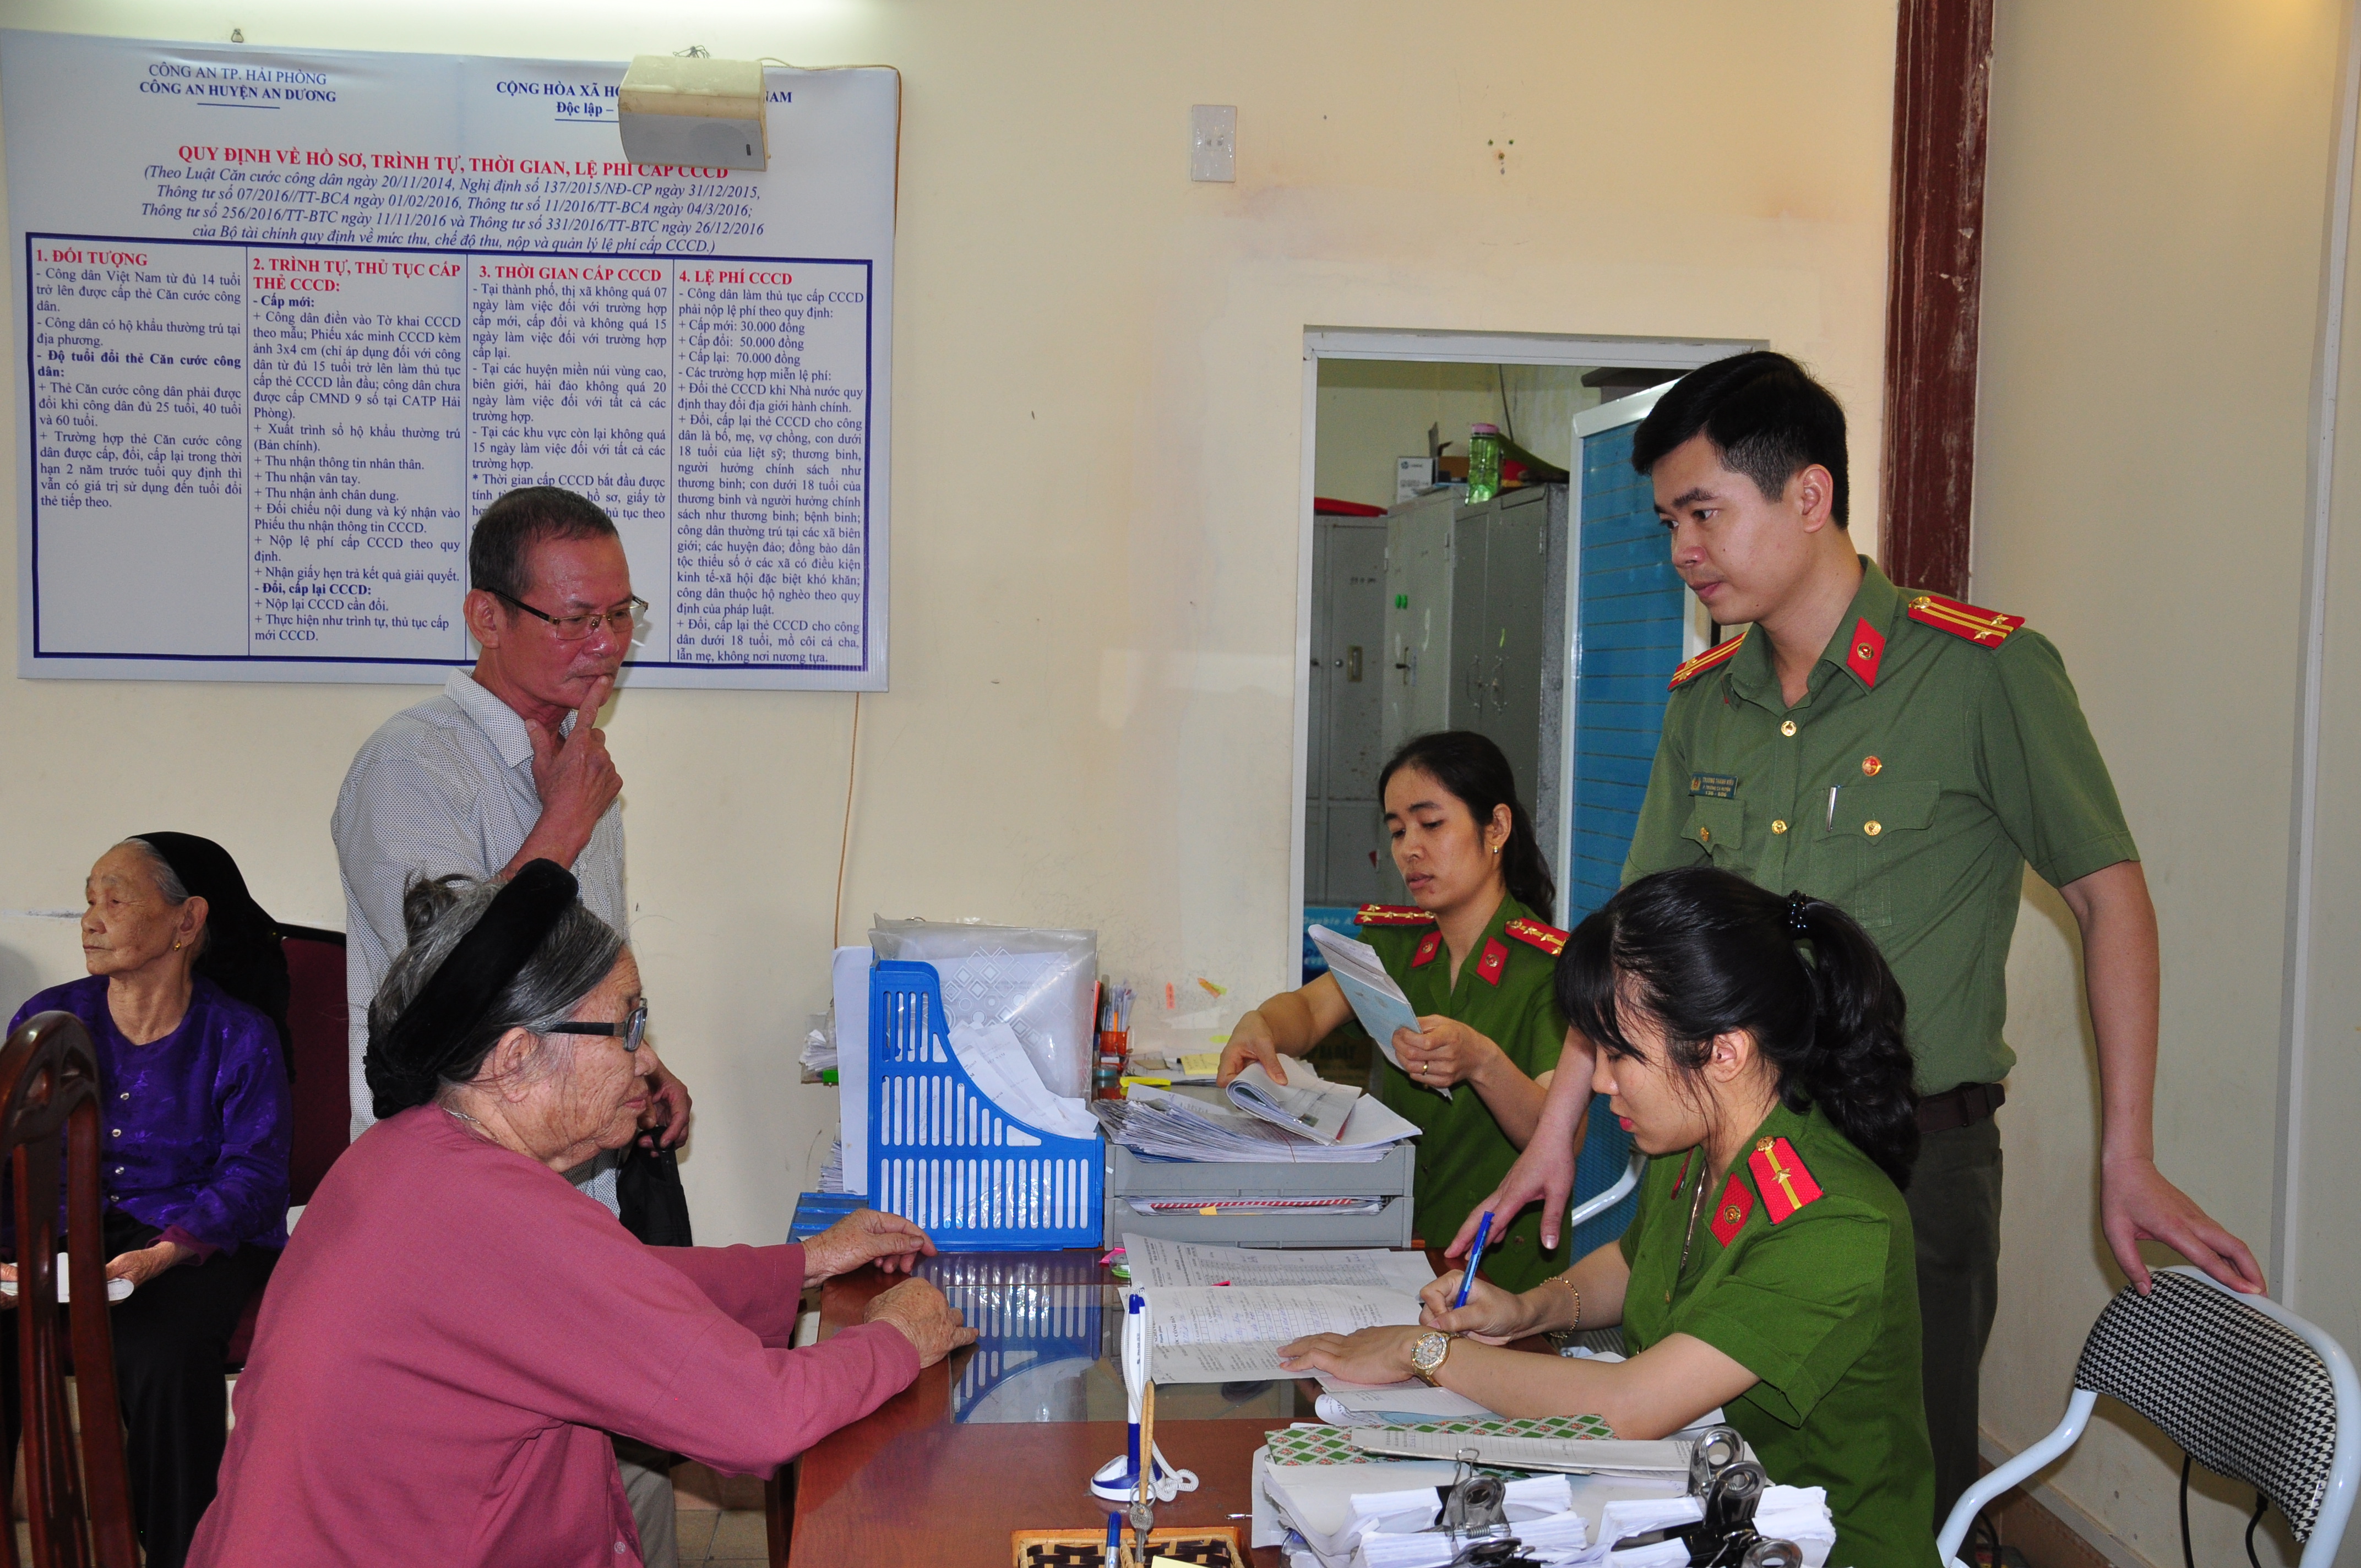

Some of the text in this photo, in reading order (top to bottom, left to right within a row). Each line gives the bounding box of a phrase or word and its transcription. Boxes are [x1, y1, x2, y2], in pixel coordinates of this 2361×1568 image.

[149, 64, 326, 85] CÔNG AN TP. HẢI PHÒNG
[139, 78, 336, 102] CÔNG AN HUYỆN AN DƯƠNG
[496, 79, 539, 97] CỘNG
[543, 80, 575, 96] HÒA
[580, 81, 600, 96] XÃ
[766, 91, 792, 103] AM
[556, 101, 602, 117] Độc lập
[178, 145, 219, 164] QUY
[224, 148, 271, 166] ĐỊNH
[276, 145, 301, 165] VỀ
[306, 147, 333, 166] HỒ
[338, 151, 366, 170] SƠ,
[371, 150, 429, 170] TRÌNH
[434, 154, 465, 175] TỰ,
[469, 153, 514, 173] THỜI
[520, 159, 570, 177] GIAN,
[575, 159, 597, 179] LỆ
[678, 166, 728, 179] CCCD
[144, 165, 760, 199] (Theo Luật Căn cước công dân ngày 20/11/2014, Nghị định số 137/2015/NĐ-CP ngày 31/12/2015,
[157, 184, 198, 202] Thông
[202, 188, 216, 199] tư
[218, 187, 232, 199] số
[353, 193, 385, 209] ngày
[388, 193, 461, 210] 01/02/2016,
[468, 196, 507, 213] Thông
[510, 200, 526, 211] tư
[528, 195, 541, 211] số
[546, 199, 649, 215] 11/2016/TT-BCA
[653, 201, 683, 218] ngày
[687, 202, 752, 217] 04/3/2016;
[142, 202, 764, 236] Thông tư số 256/2016/TT-BTC ngày 11/11/2016 và Thông tư số 331/2016/TT-BTC ngày 26/12/2016
[193, 224, 715, 254] của Bộ tài chính quy định về mức thu, chế độ thu, nộp và quản lý lệ phí cấp CCCD.)
[37, 246, 148, 269] 1. ĐỐI TƯỢNG
[253, 255, 460, 279] 2. TRÌNH TỰ, THỦ TỤC CẤP
[479, 262, 661, 282] 3. THỜI GIAN CẤP CCCD
[679, 267, 792, 286] 4. LỆ PHÍ CCCD
[253, 273, 340, 292] THẺ CCCD:
[36, 284, 241, 304] trở lên được cấp thẻ Căn cước công
[472, 313, 666, 332] cấp mới, cấp đổi và không quá 15
[679, 303, 833, 322] phải nộp lệ phí theo quy định:
[253, 325, 461, 344] theo mẫu; Phiếu xác minh CCCD kèm
[676, 602, 774, 617] định của pháp luật.
